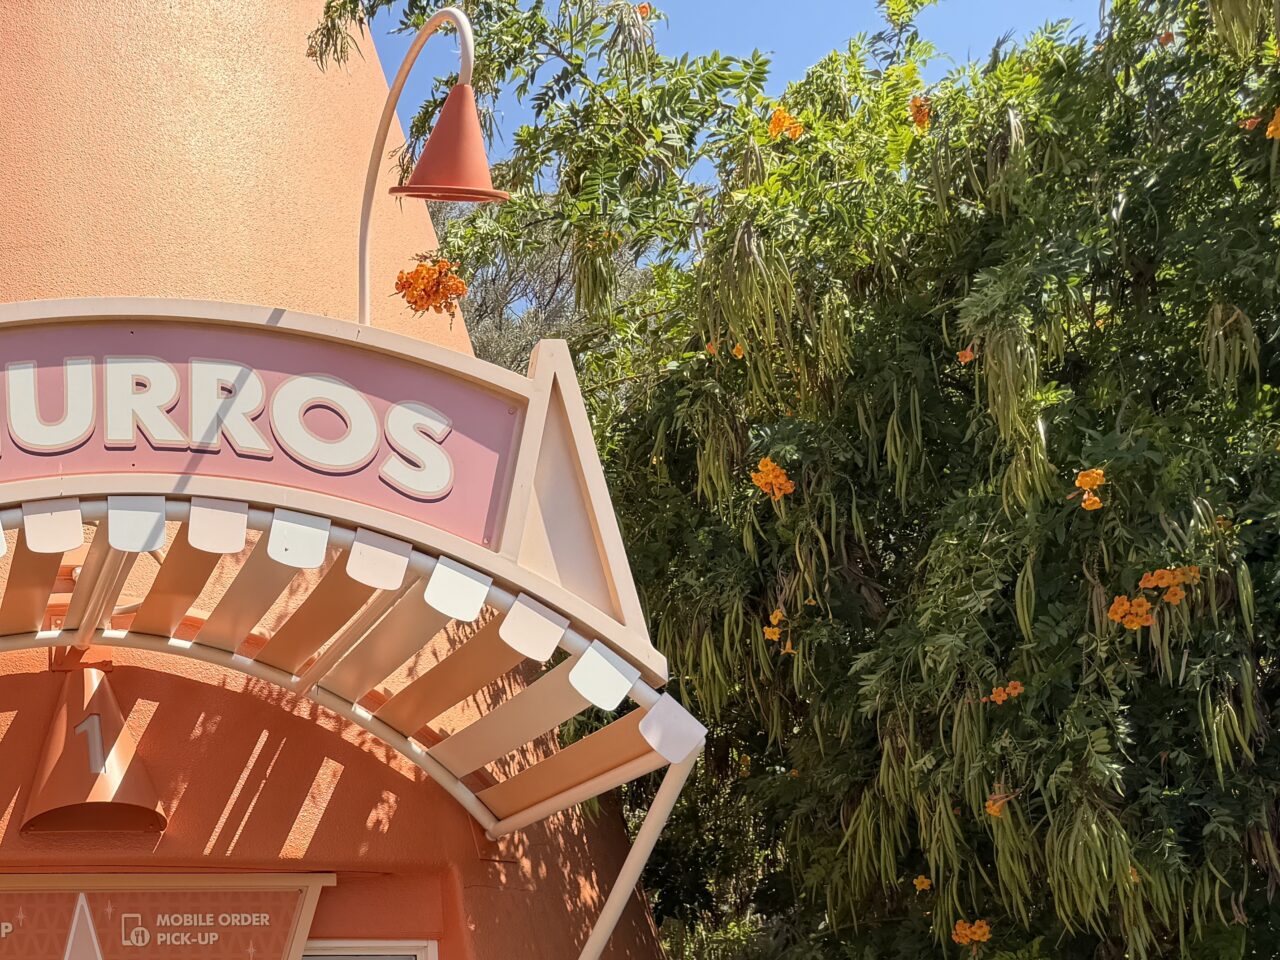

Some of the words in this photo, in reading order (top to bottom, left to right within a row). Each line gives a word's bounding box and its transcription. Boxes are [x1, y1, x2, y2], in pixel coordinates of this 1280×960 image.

[74, 713, 106, 774] 1
[156, 913, 214, 927] MOBILE
[218, 913, 270, 927] ORDER
[156, 932, 219, 946] PICK-UP
